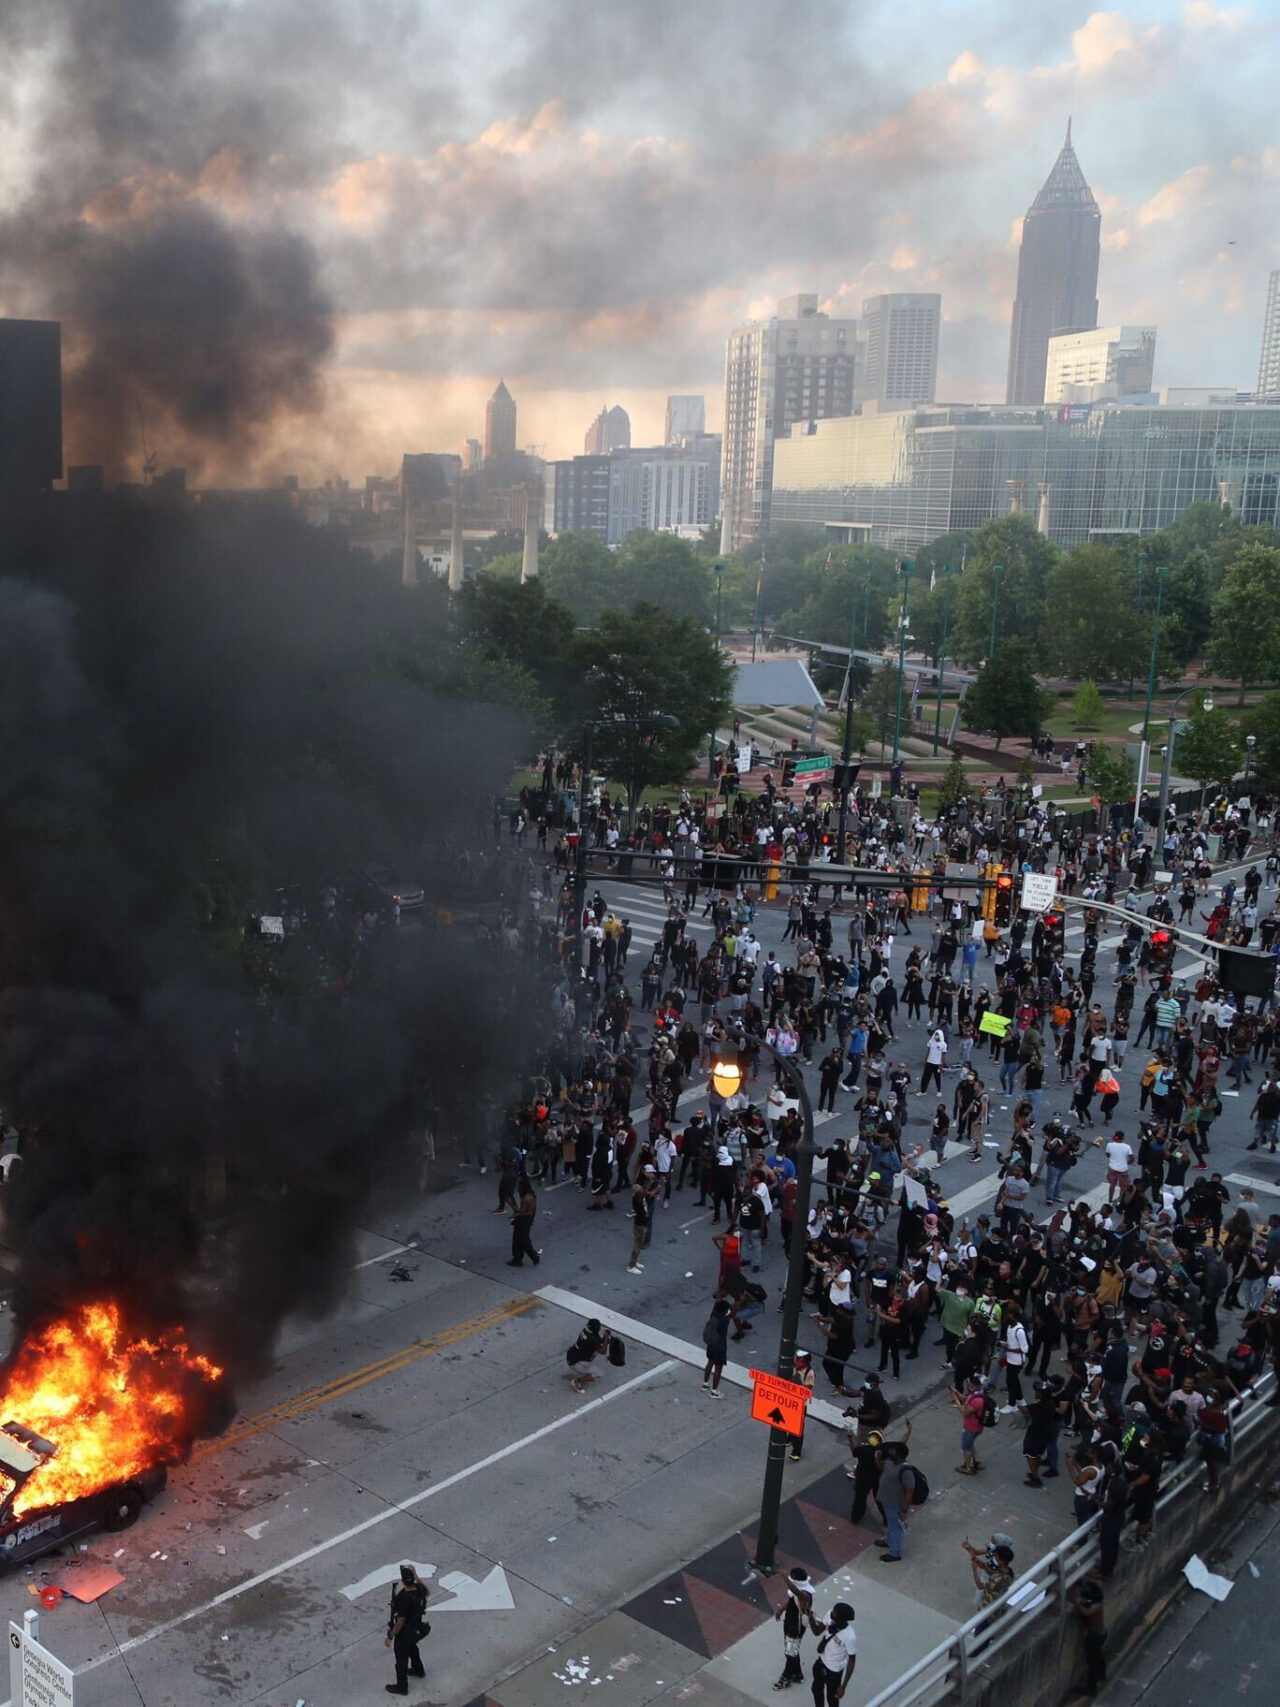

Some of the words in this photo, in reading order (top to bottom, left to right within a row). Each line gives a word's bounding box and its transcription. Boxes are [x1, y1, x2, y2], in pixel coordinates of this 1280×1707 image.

[750, 1370, 765, 1381] TED
[768, 1376, 797, 1392] TURNER
[799, 1387, 810, 1398] DR
[758, 1388, 799, 1411] DETOUR
[23, 1644, 46, 1670] Georgia
[46, 1662, 65, 1686] World
[23, 1653, 51, 1683] Congress
[51, 1677, 72, 1701] Center
[24, 1668, 55, 1701] Centennial
[24, 1677, 48, 1704] Olympic
